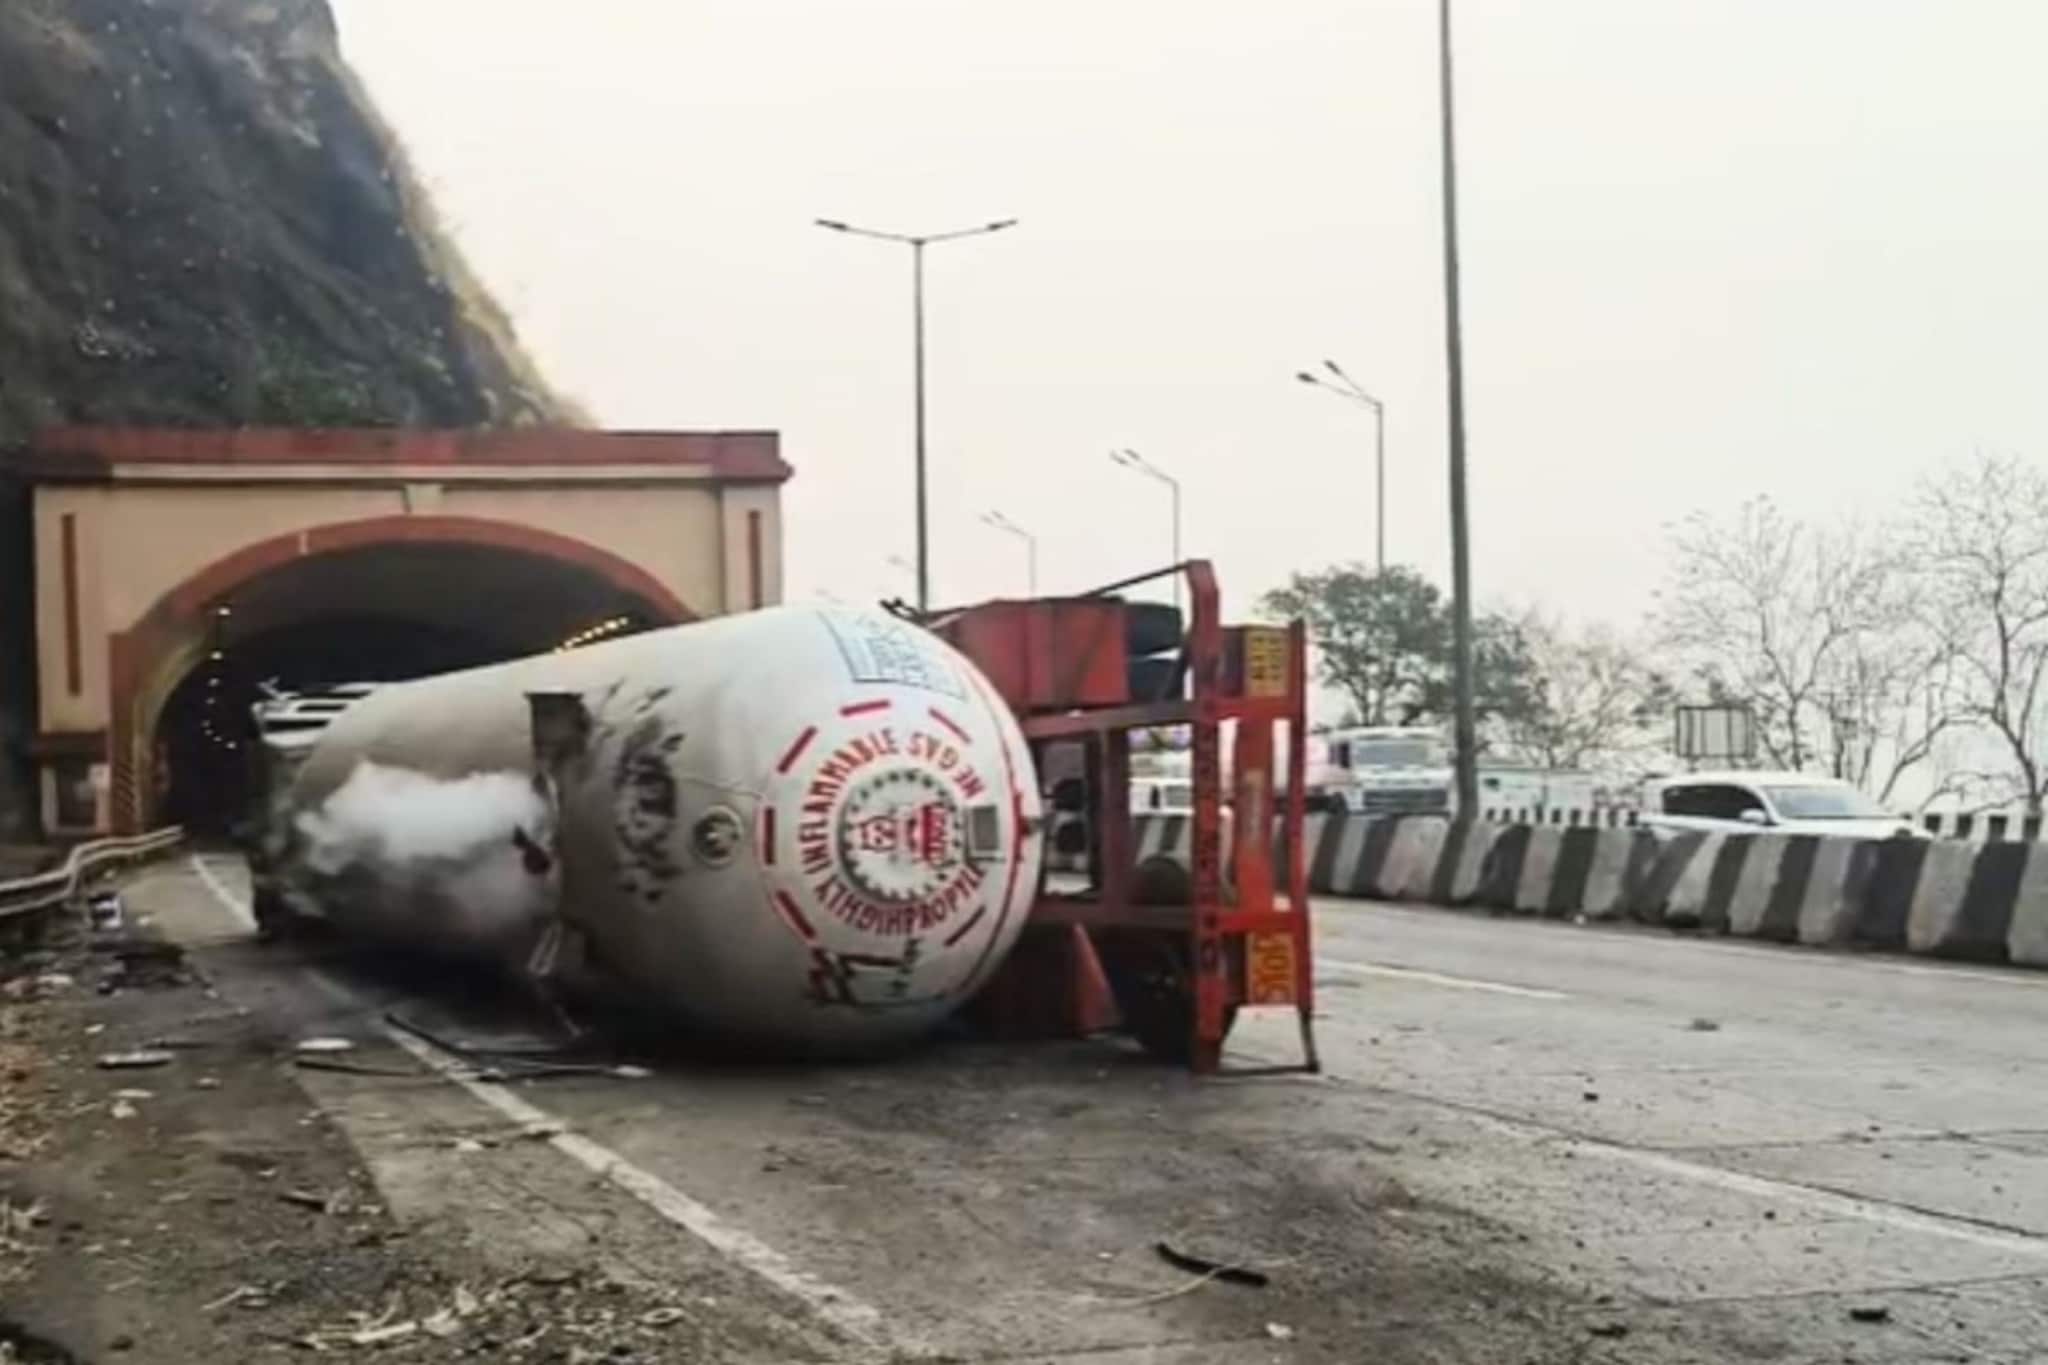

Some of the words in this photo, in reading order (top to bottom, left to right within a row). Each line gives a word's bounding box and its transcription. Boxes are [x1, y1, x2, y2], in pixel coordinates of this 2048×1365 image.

[907, 731, 959, 769] GAS
[798, 728, 898, 874] INFLAMMABLE
[816, 873, 901, 935] HIGHLY
